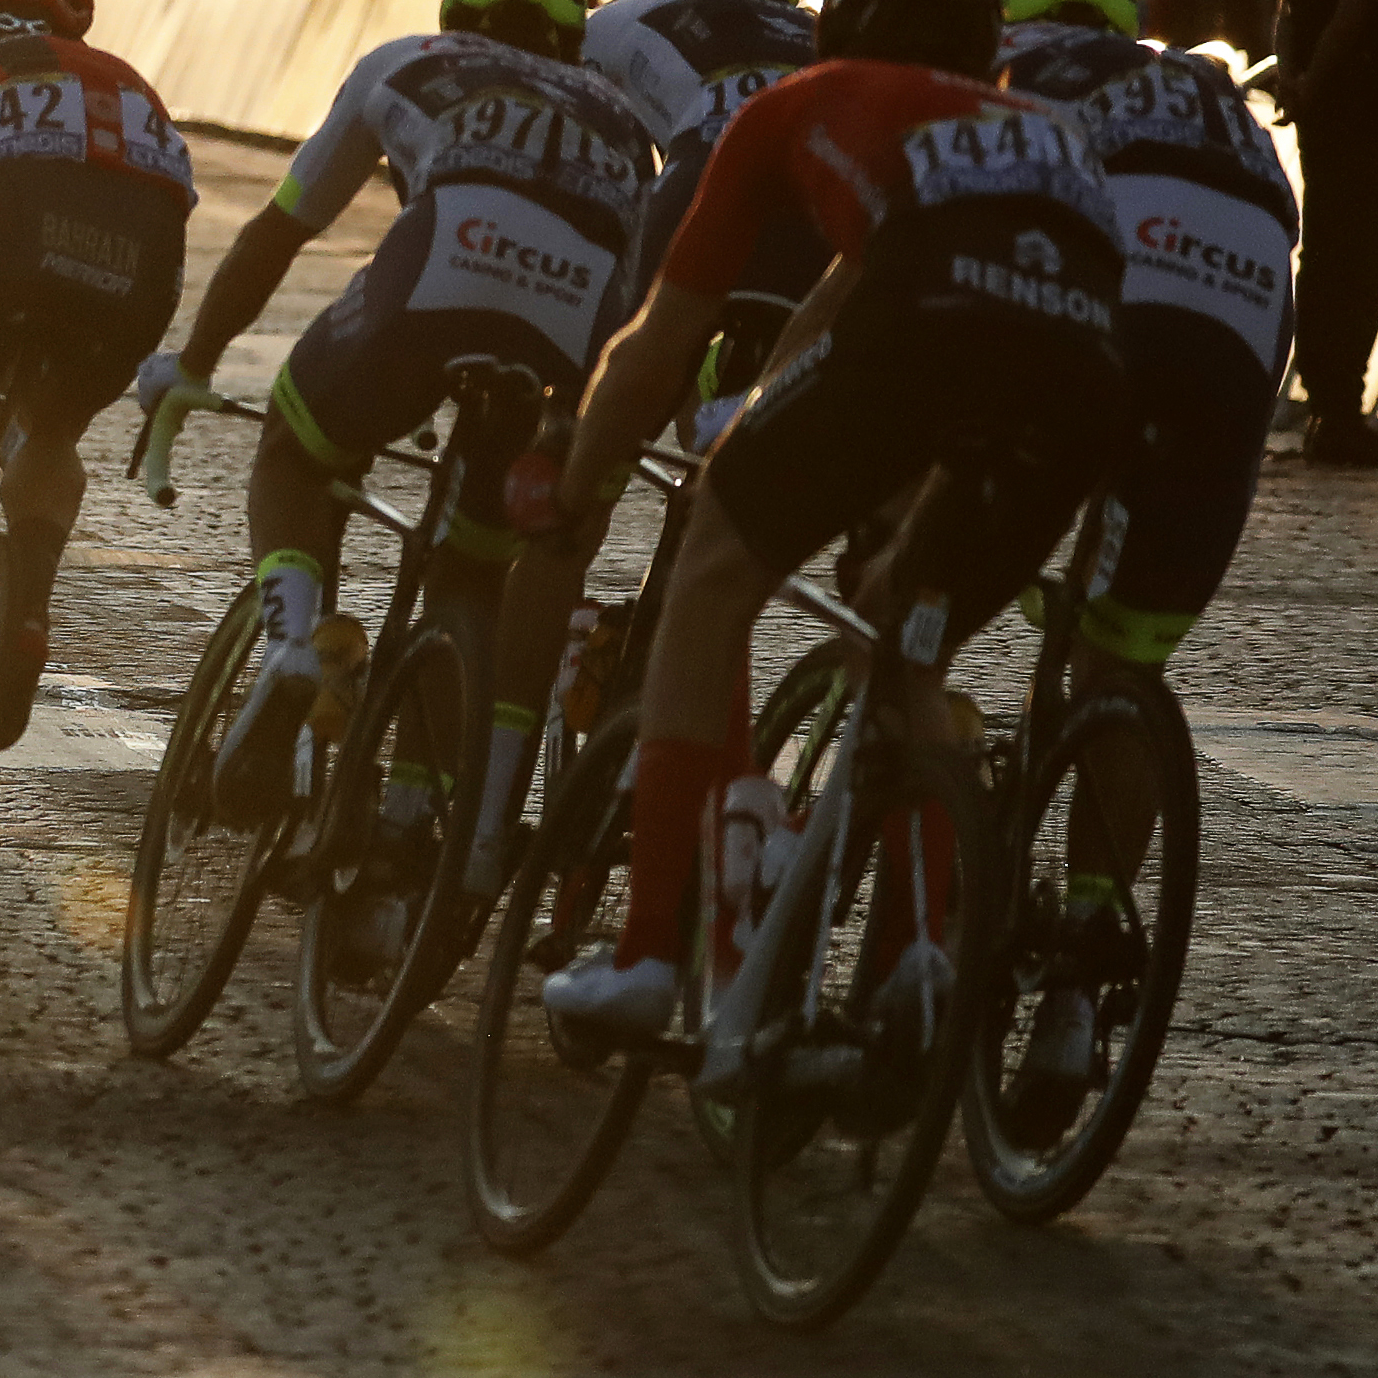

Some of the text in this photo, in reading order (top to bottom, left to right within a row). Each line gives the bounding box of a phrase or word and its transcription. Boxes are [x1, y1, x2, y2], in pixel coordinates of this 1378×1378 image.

[707, 69, 771, 116] 19
[916, 113, 1030, 173] 144
[456, 216, 592, 289] Circus
[1137, 216, 1277, 292] Circus
[951, 255, 1113, 330] RENSON
